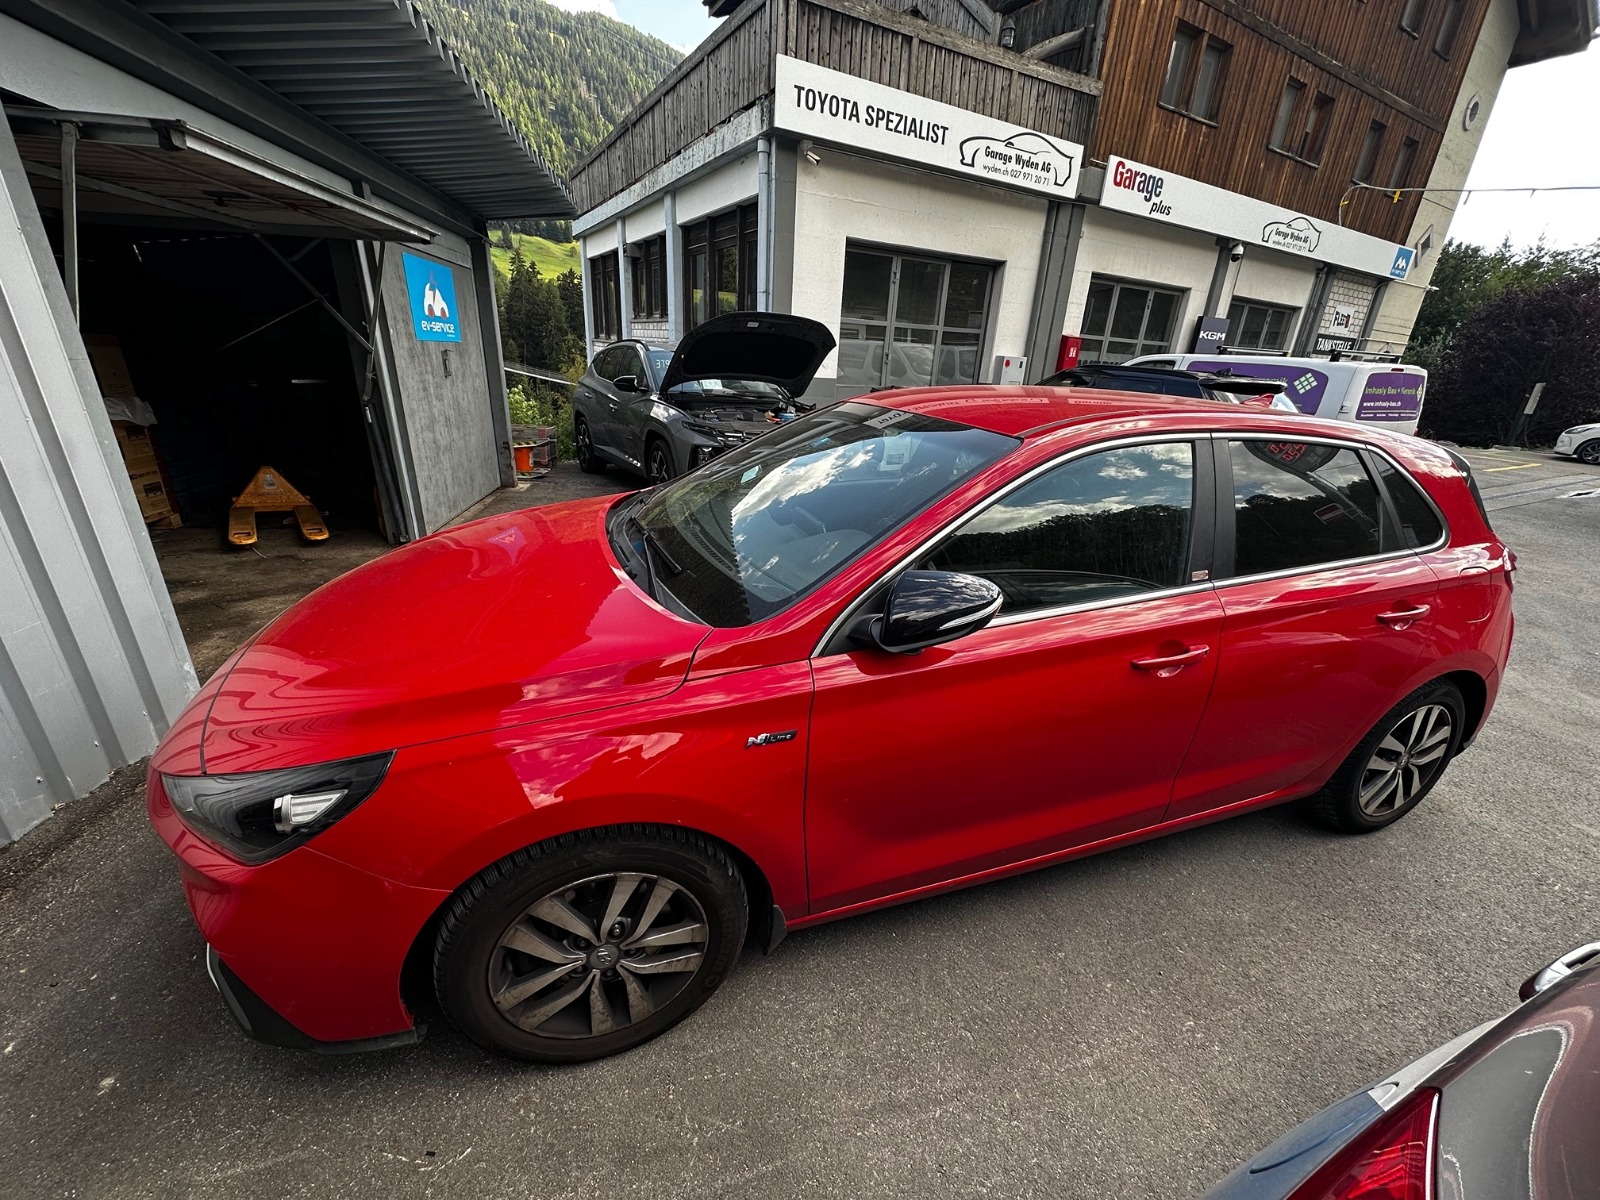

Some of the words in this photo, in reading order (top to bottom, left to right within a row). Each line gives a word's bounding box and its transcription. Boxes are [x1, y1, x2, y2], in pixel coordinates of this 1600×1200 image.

[794, 84, 860, 123] TOYOTA
[864, 105, 949, 145] SPEZIALIST
[985, 145, 1013, 165] Garage
[1015, 153, 1039, 170] Wyden
[1040, 161, 1052, 173] AG
[982, 163, 1009, 176] wyden.ch
[1009, 168, 1022, 179] 027
[1022, 171, 1033, 183] 971
[1034, 174, 1042, 184] 20
[1042, 177, 1050, 186] 71
[1113, 160, 1164, 202] Garage
[1149, 200, 1172, 215] plus
[1274, 227, 1290, 241] Garage
[1289, 231, 1303, 243] Wyden
[1302, 235, 1310, 244] AG
[421, 320, 455, 333] ev-service
[1199, 330, 1226, 341] KGM
